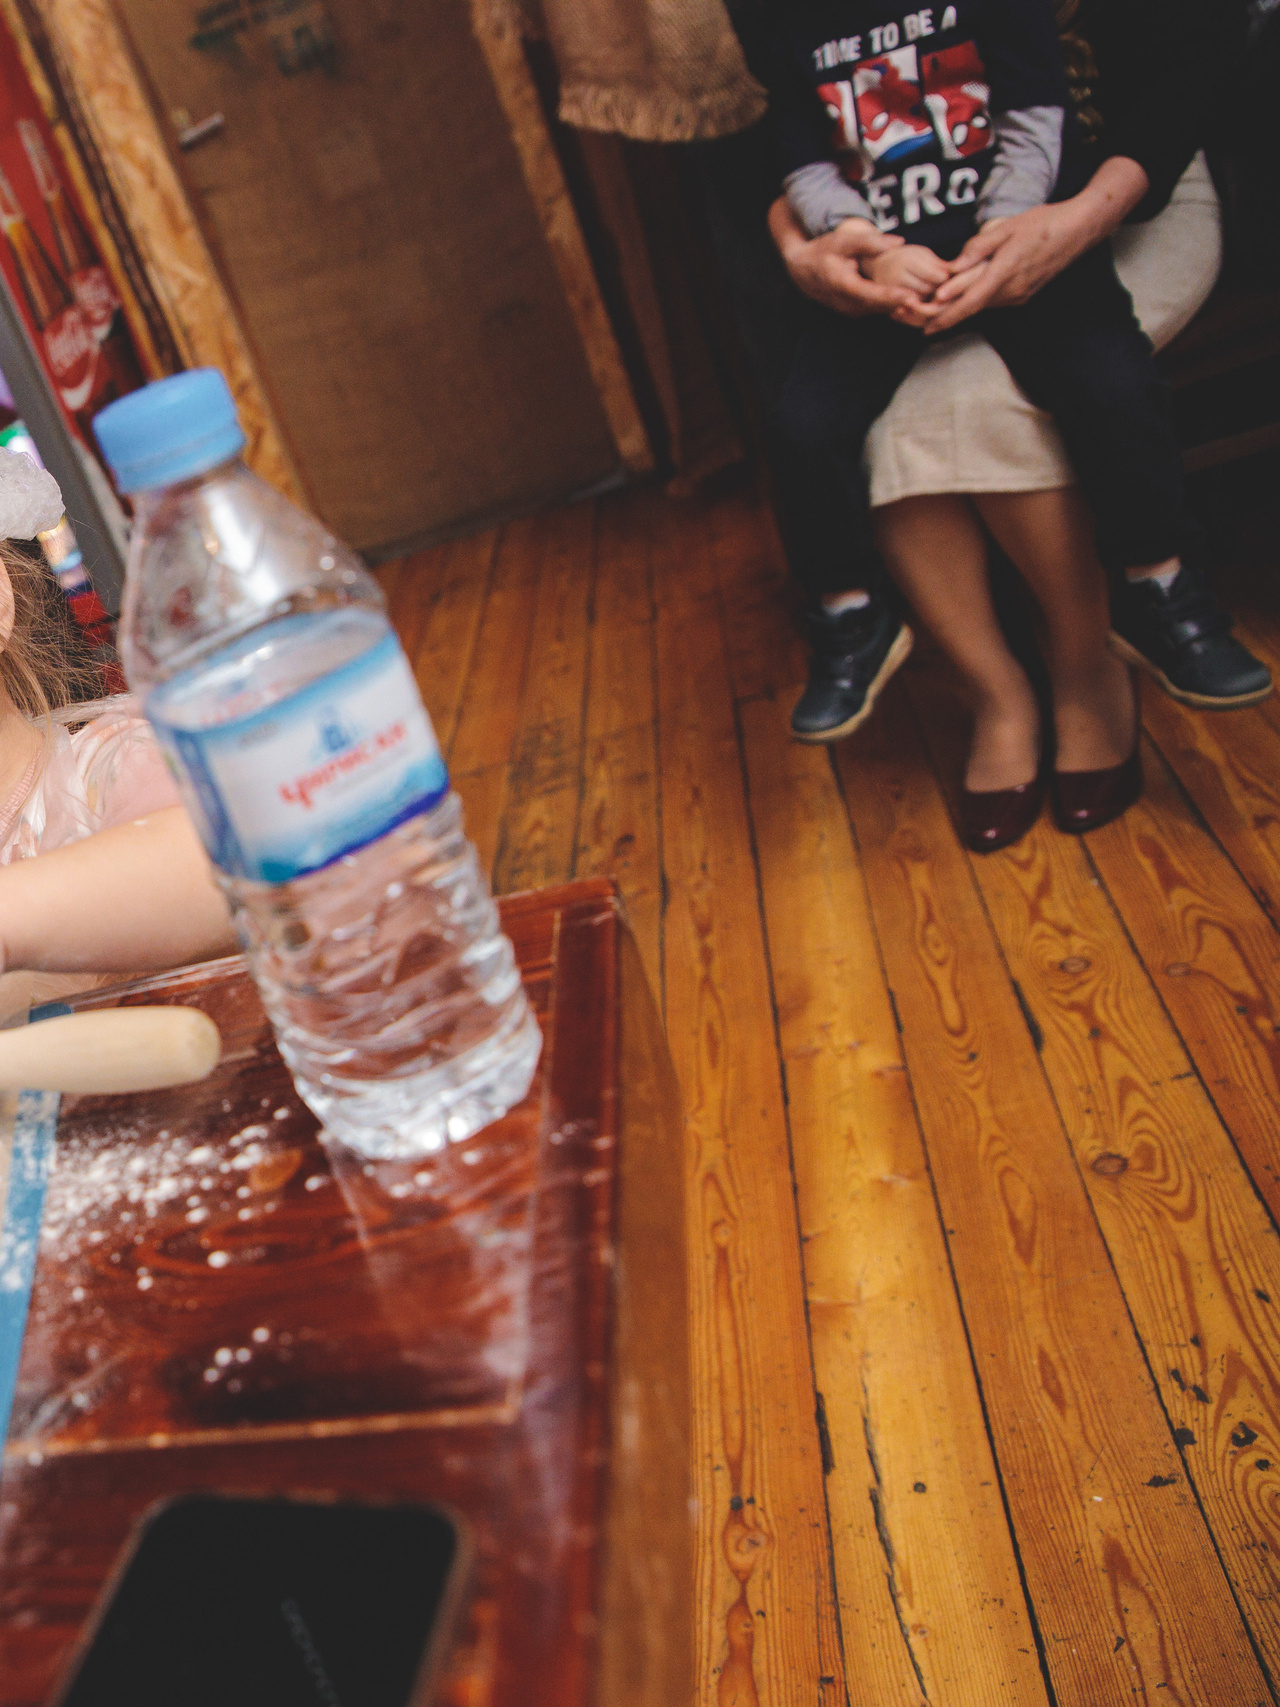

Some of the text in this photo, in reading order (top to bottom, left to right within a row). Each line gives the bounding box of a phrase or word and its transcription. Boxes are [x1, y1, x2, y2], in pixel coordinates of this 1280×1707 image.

[869, 21, 899, 54] TO
[903, 8, 936, 42] BE
[940, 5, 957, 32] A
[866, 163, 979, 232] ERO
